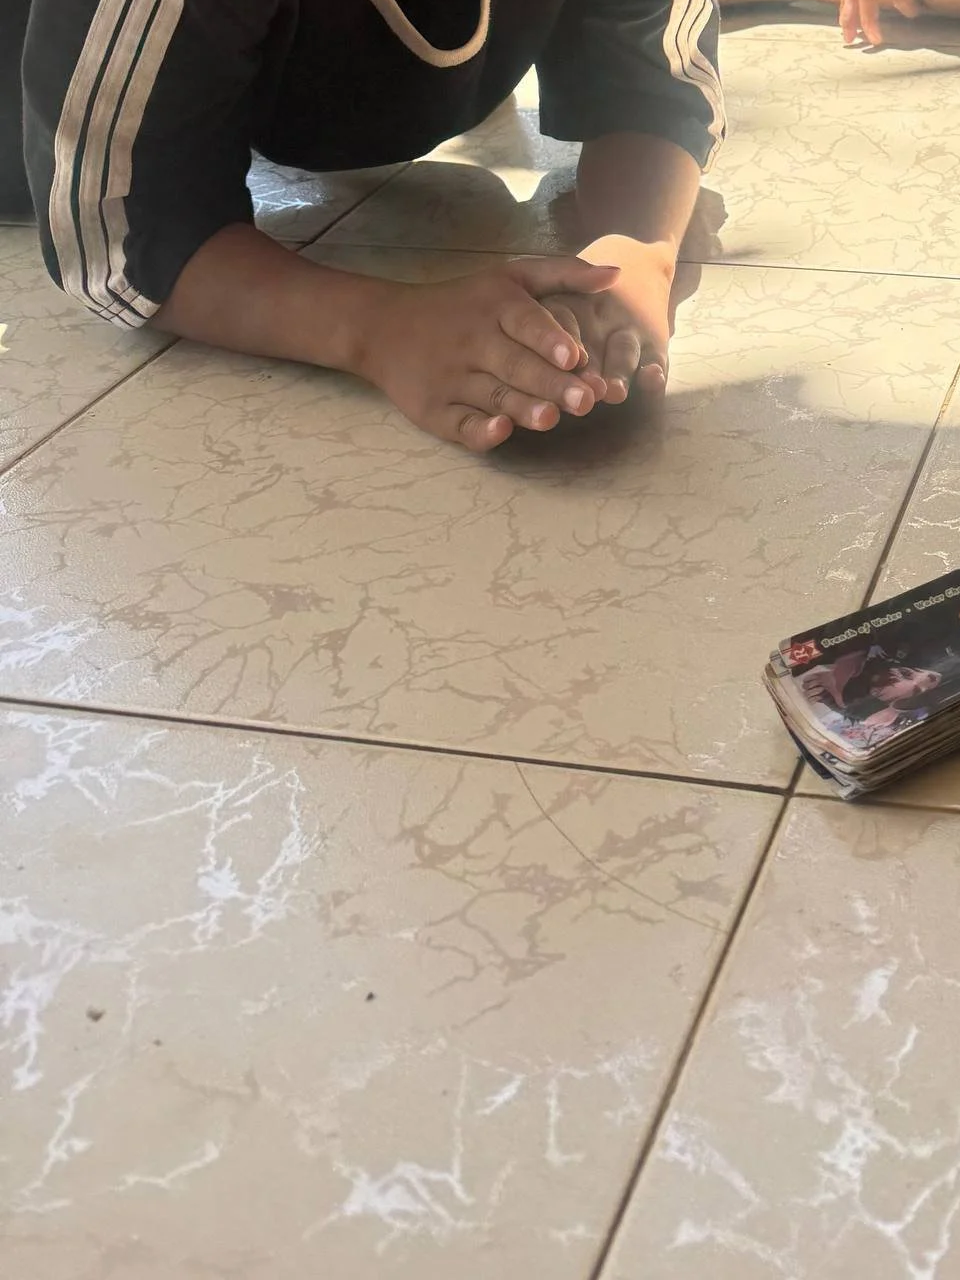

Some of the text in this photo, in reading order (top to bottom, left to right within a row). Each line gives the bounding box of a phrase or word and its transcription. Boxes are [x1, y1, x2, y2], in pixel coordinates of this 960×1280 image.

[858, 622, 871, 634] of
[870, 611, 902, 628] Water
[913, 593, 945, 610] Water
